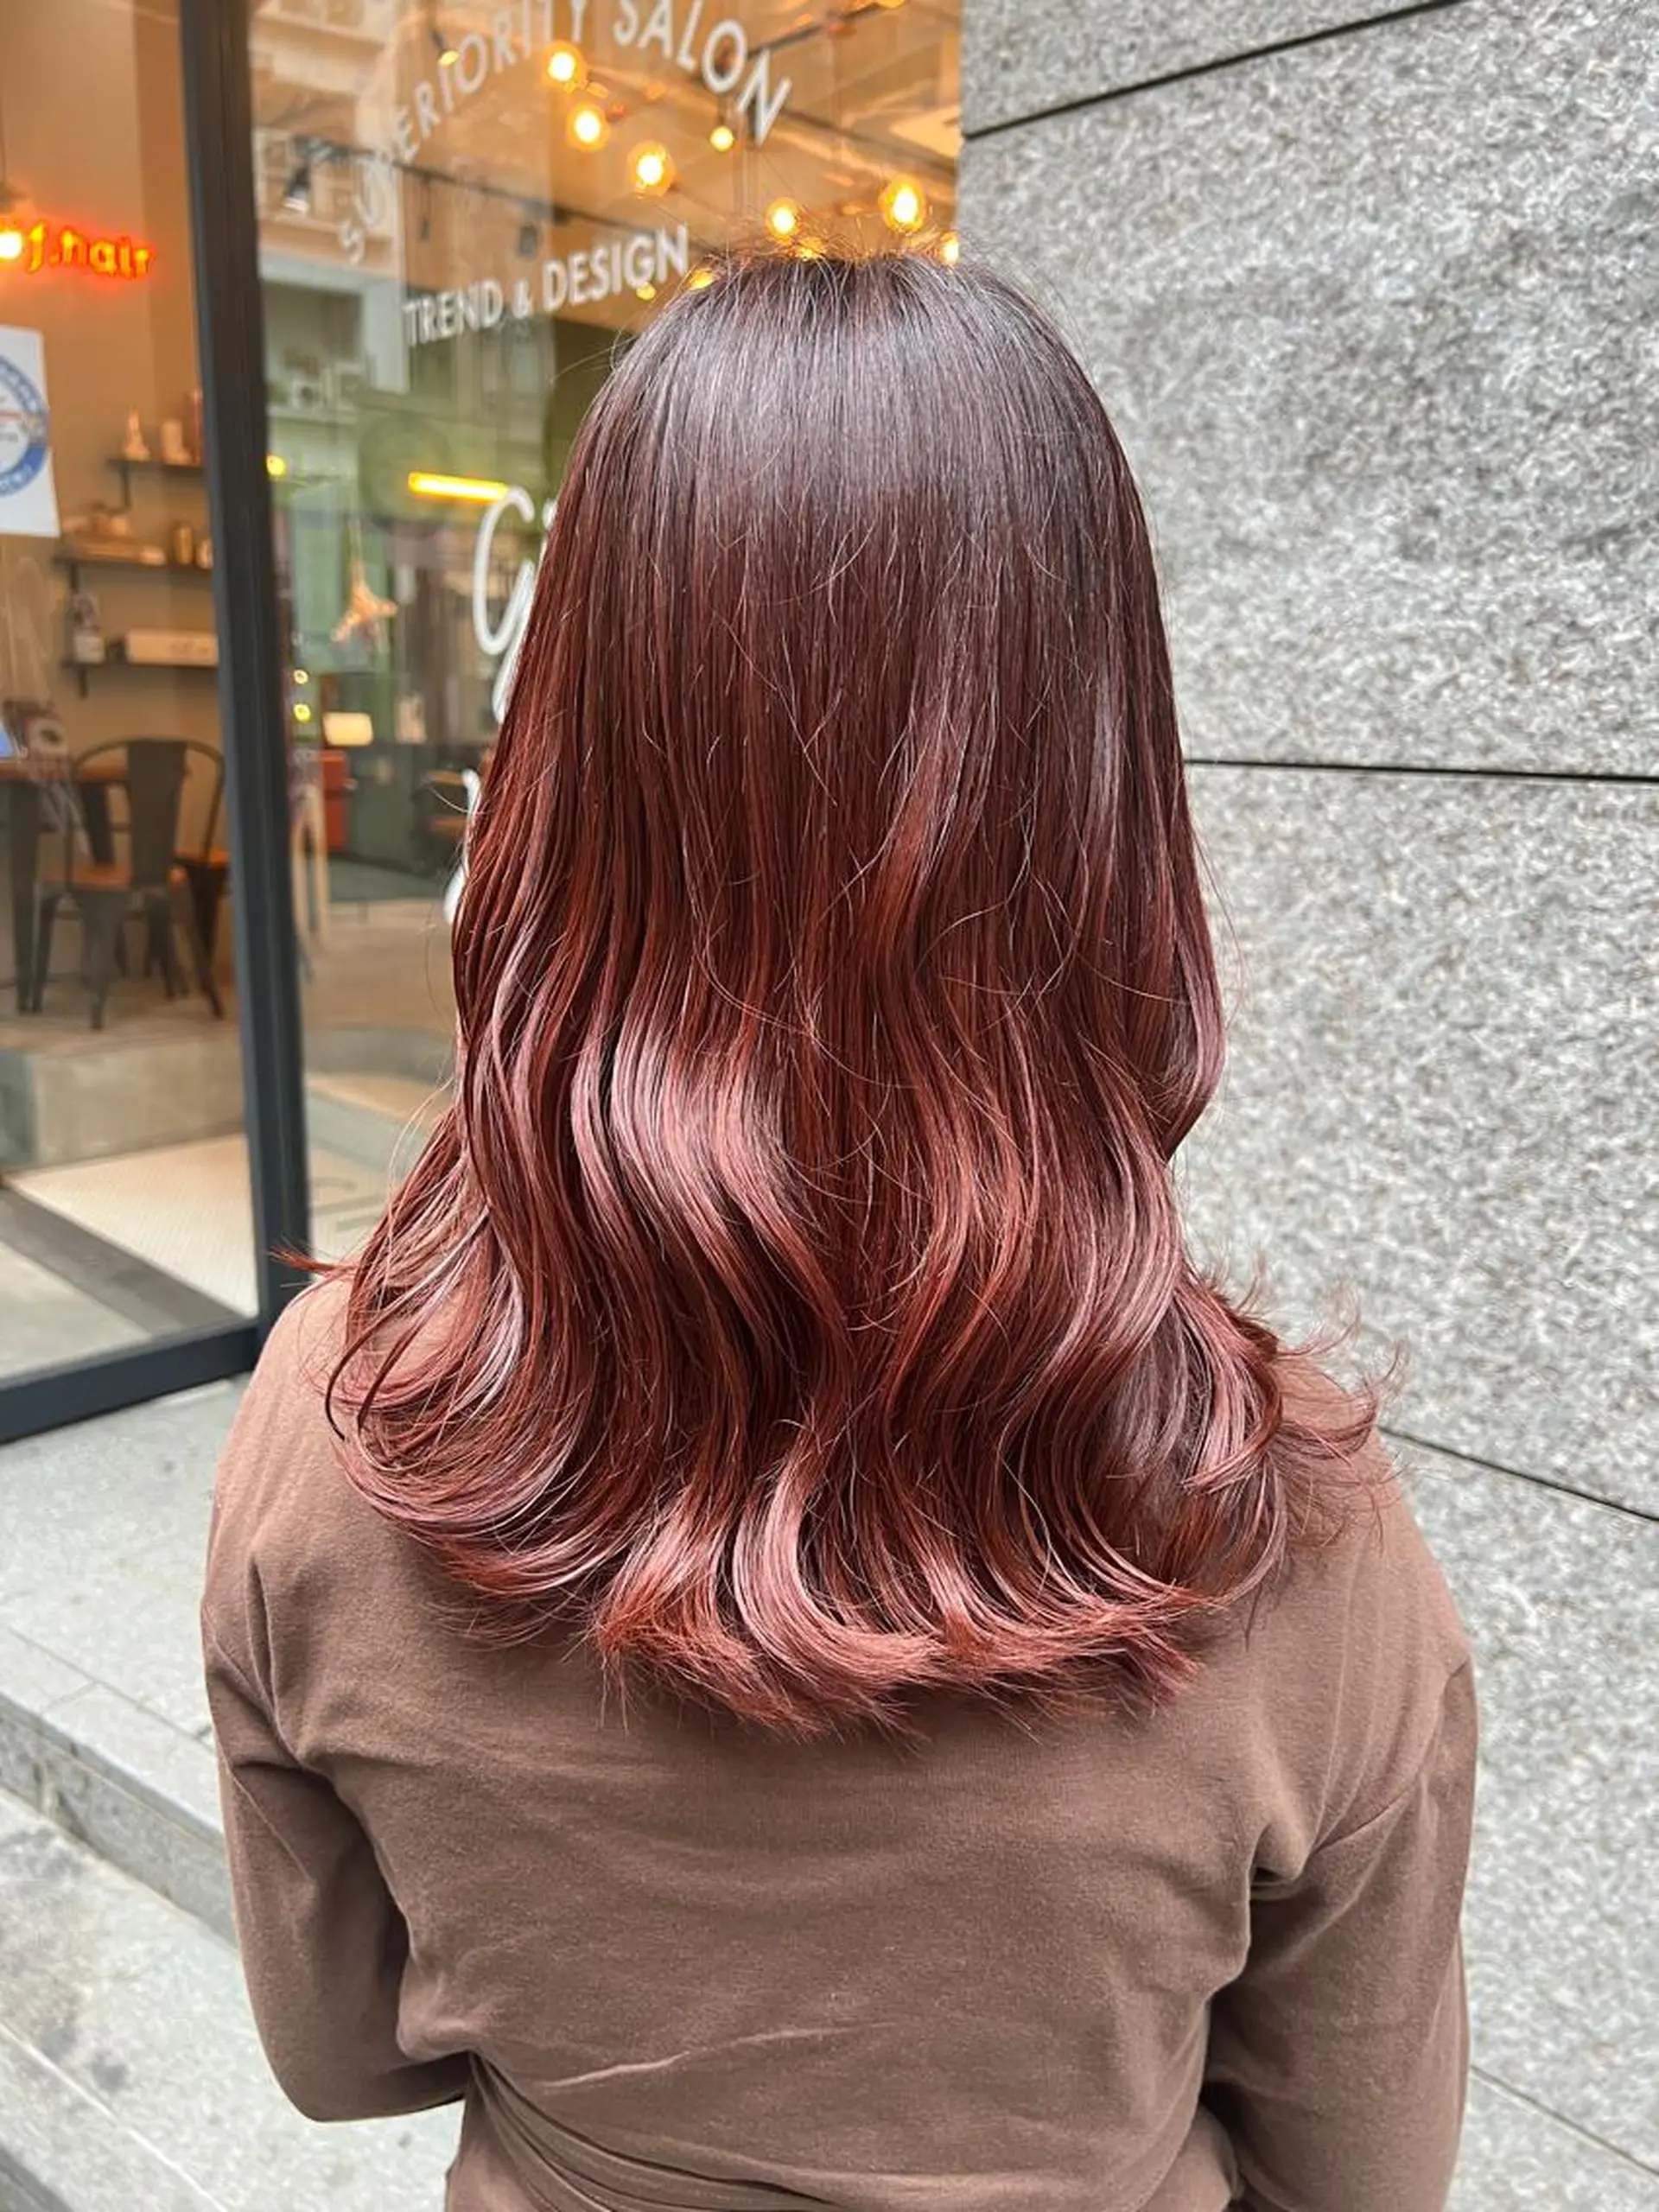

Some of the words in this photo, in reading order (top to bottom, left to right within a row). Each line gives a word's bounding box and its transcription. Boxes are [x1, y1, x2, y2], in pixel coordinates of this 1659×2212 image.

[613, 0, 792, 145] SALON
[402, 279, 504, 346] TREND
[512, 276, 533, 321] &
[542, 224, 689, 313] DESIGN
